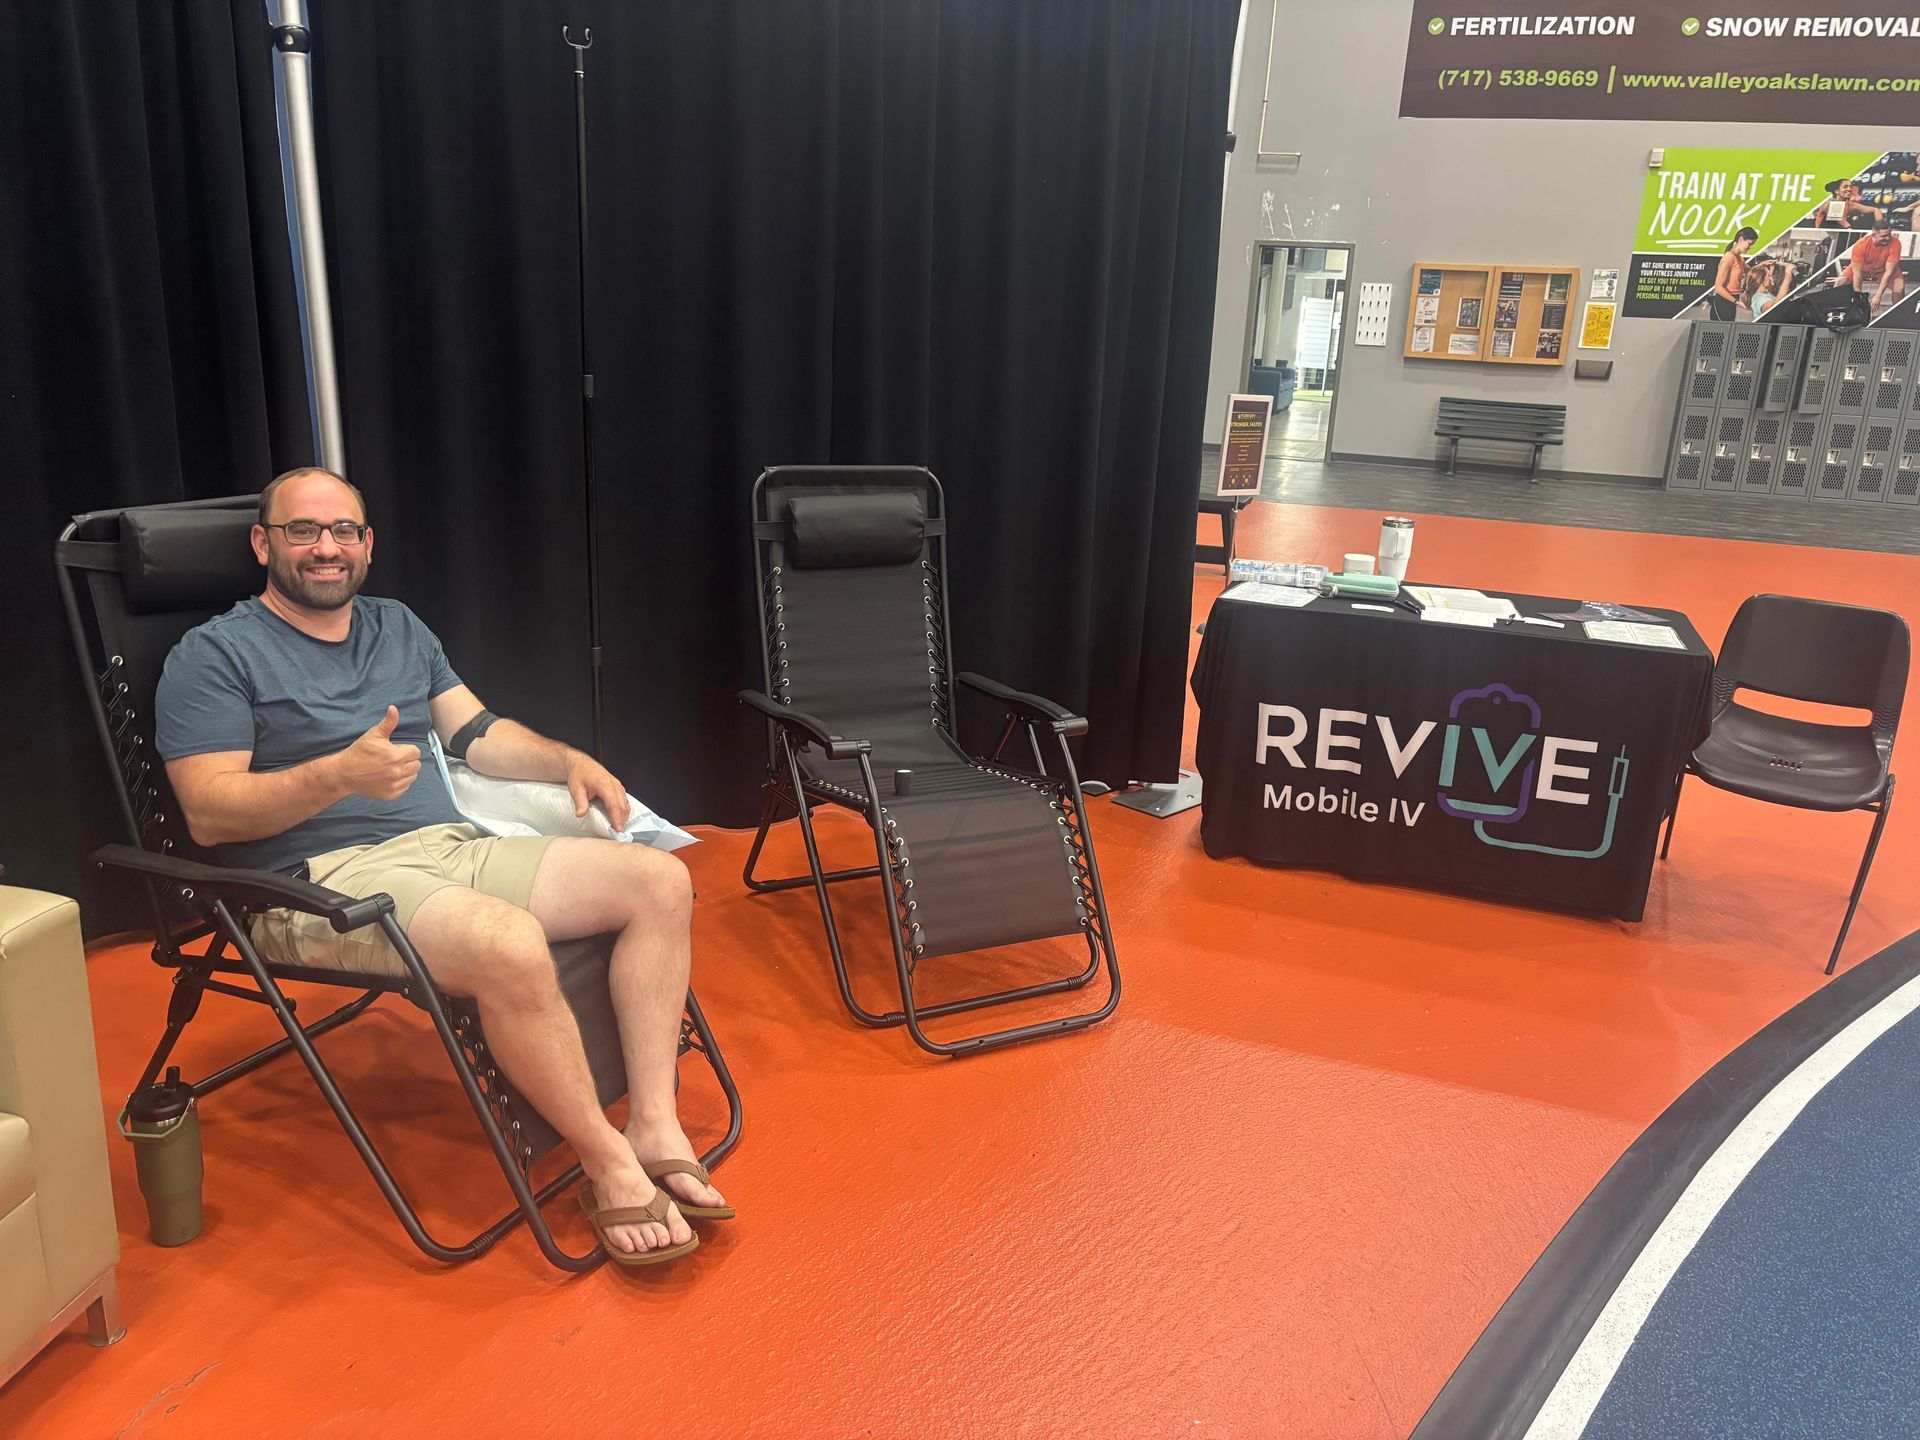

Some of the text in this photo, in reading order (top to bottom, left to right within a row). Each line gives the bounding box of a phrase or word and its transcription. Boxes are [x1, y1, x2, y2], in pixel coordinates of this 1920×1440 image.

[1450, 16, 1635, 36] FERTILIZATION
[1705, 17, 1920, 37] SNOW REMOVAL
[1438, 70, 1599, 90] (717) 538-9669
[1657, 171, 1815, 202] TRAIN AT THE
[1649, 201, 1771, 236] NOOK!
[1256, 702, 1598, 805] REVIVE
[1263, 784, 1426, 827] Mobile IV
